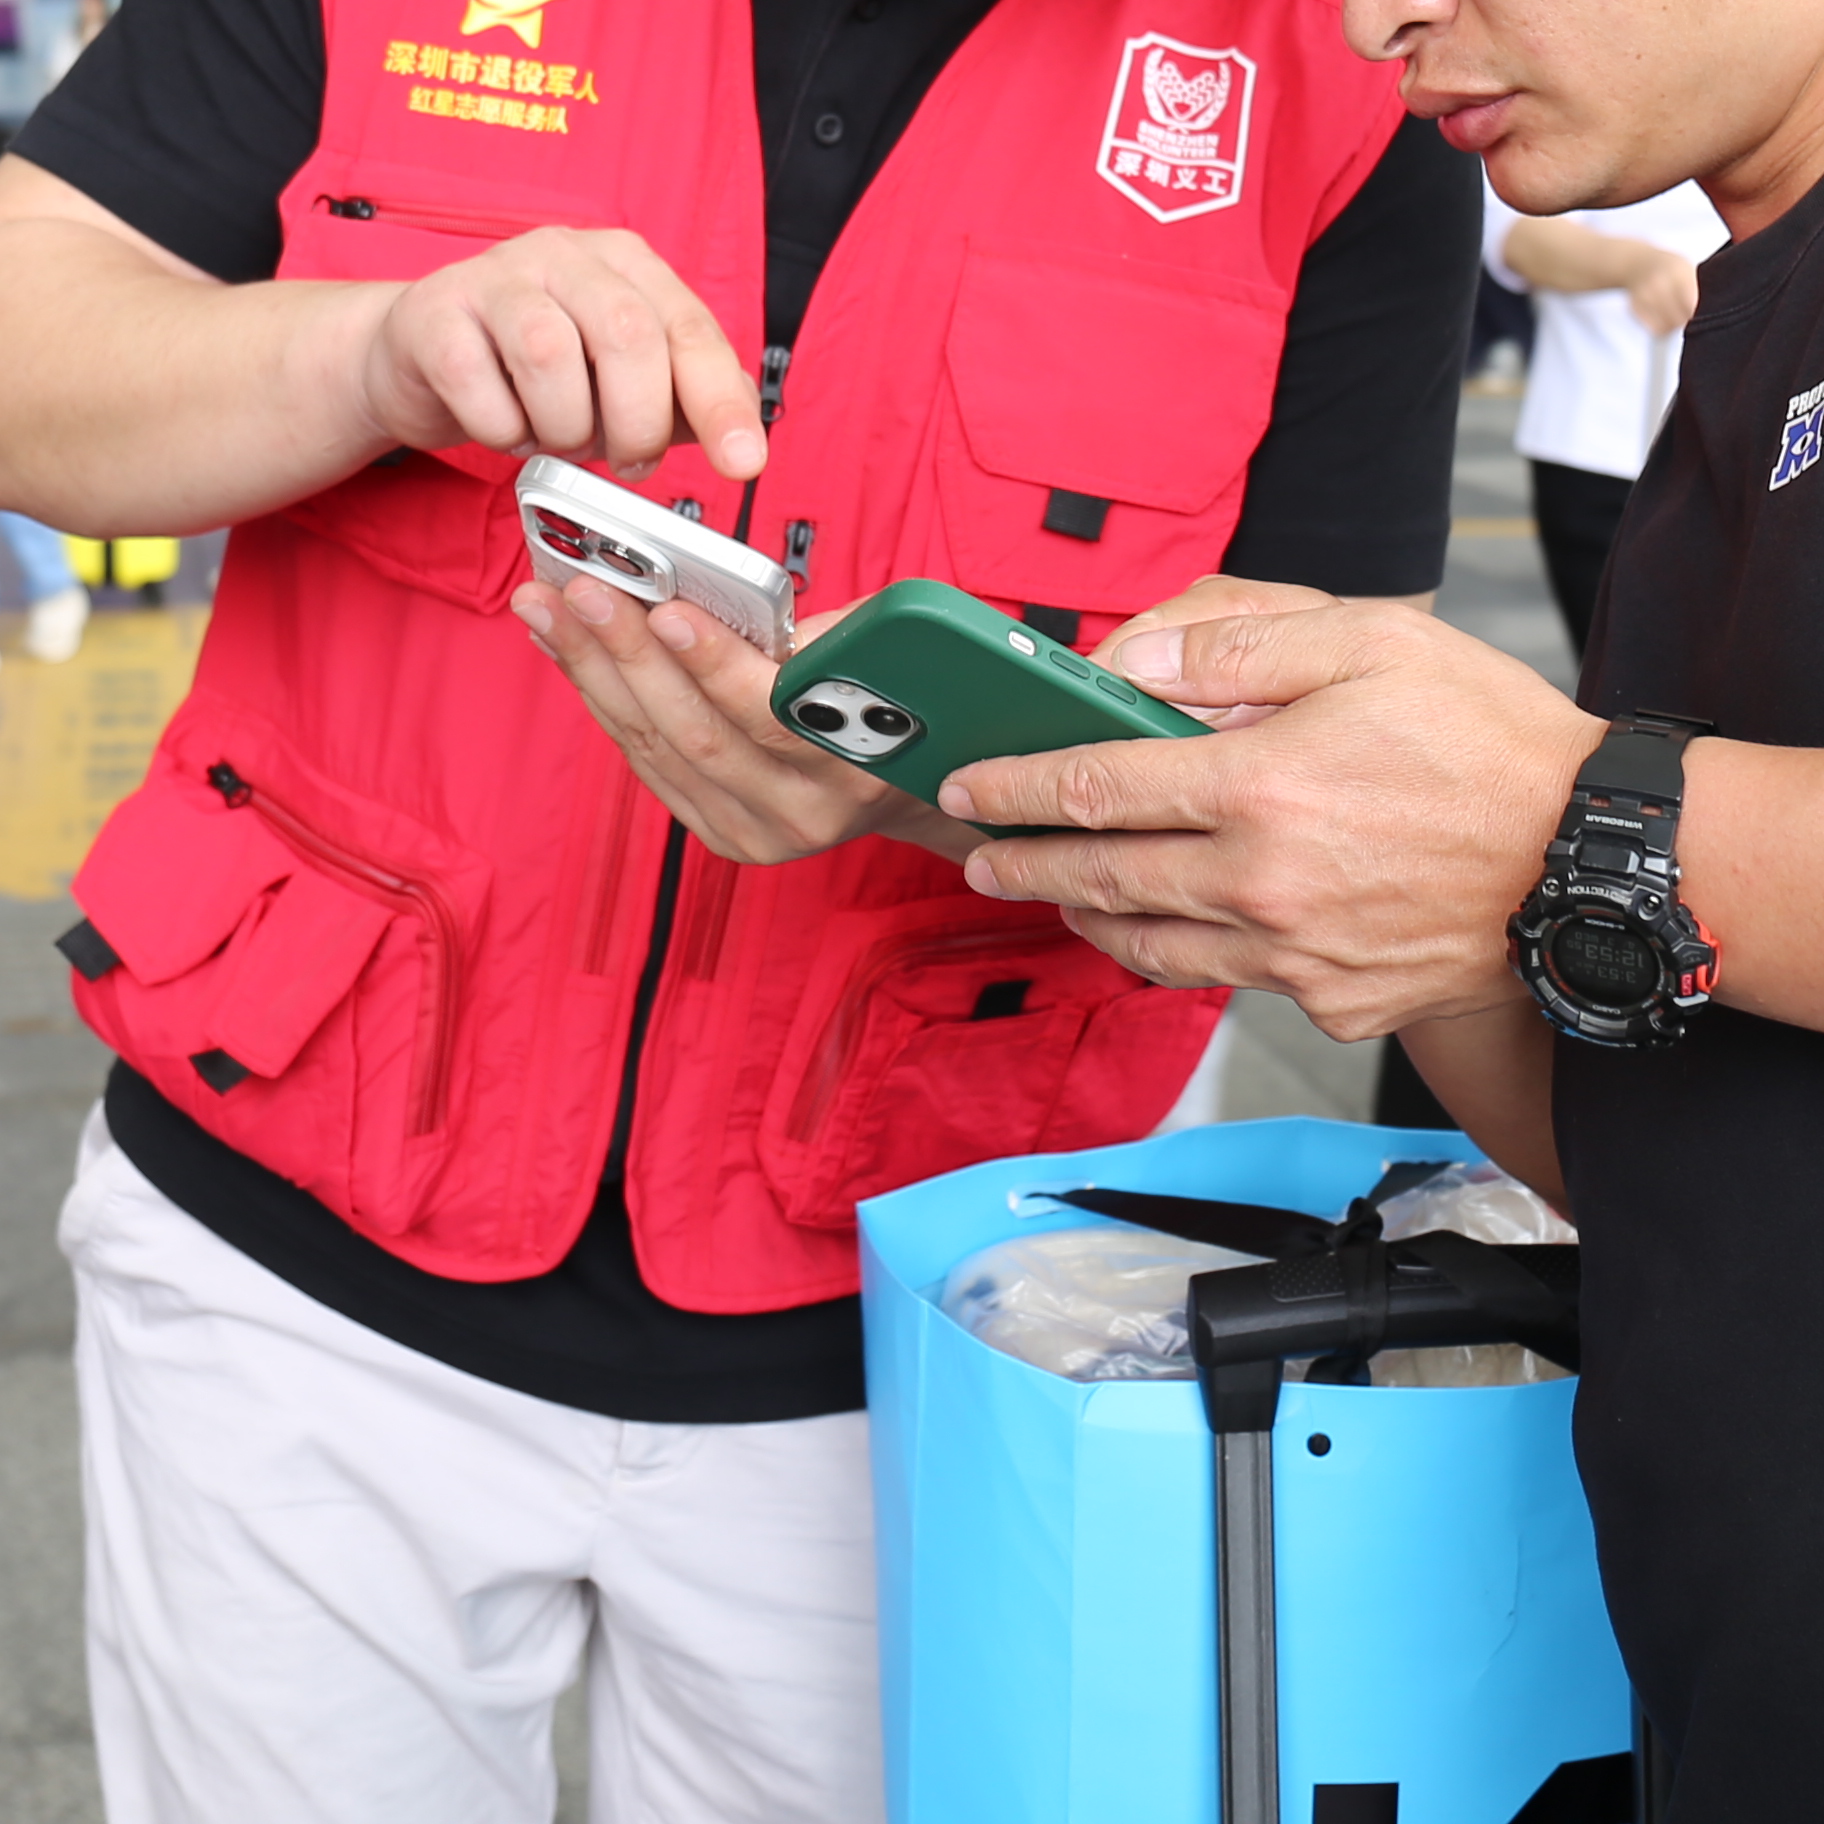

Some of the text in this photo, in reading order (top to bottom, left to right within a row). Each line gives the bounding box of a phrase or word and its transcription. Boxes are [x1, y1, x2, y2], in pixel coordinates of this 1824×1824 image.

[384, 41, 599, 104] 深圳市退役军人
[408, 86, 569, 135] 红星志愿服务队
[1113, 150, 1228, 195] 深圳义工
[1566, 885, 1633, 906] PROTECTION
[1585, 943, 1645, 969] 12:53
[1597, 965, 1637, 984] 3:53
[1591, 1003, 1622, 1015] CASIO
